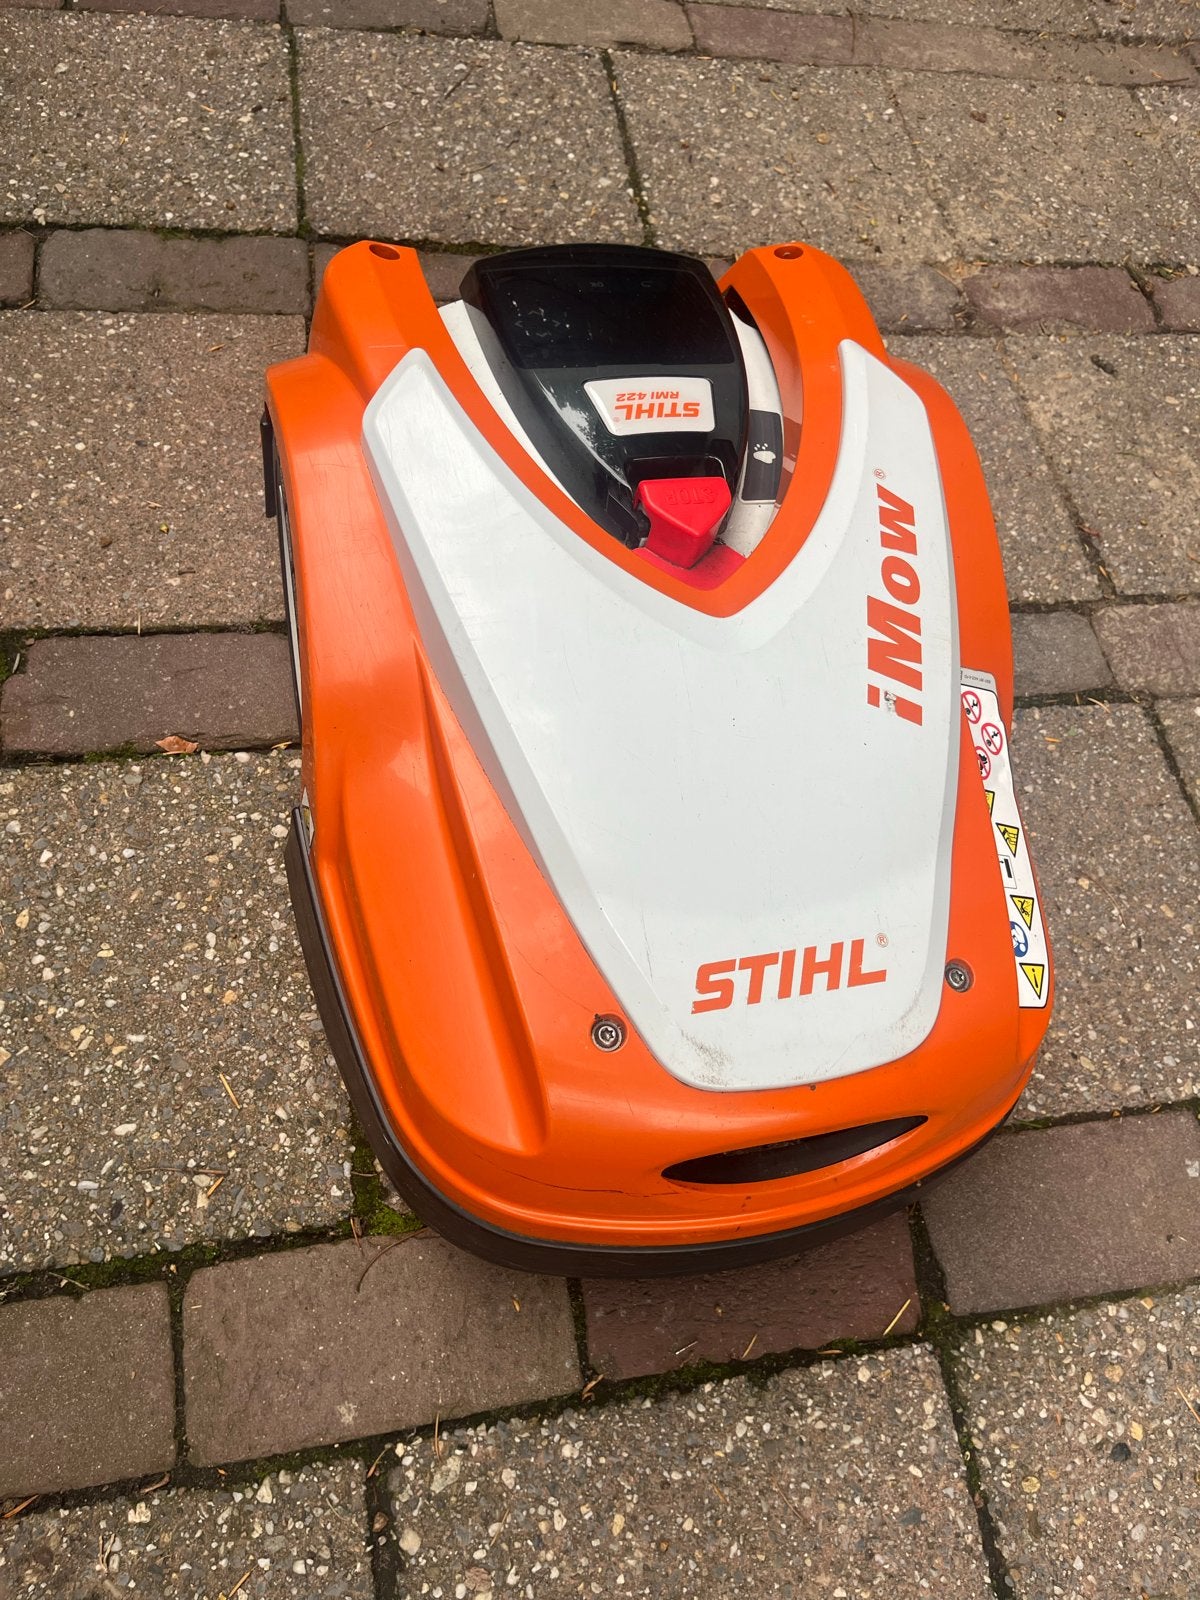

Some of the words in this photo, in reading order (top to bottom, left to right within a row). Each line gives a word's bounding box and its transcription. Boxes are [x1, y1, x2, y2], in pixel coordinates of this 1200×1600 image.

[616, 391, 647, 402] 422
[650, 391, 680, 400] RMI
[615, 402, 700, 421] STIHL
[663, 487, 716, 506] STOP
[691, 938, 887, 1015] STIHL
